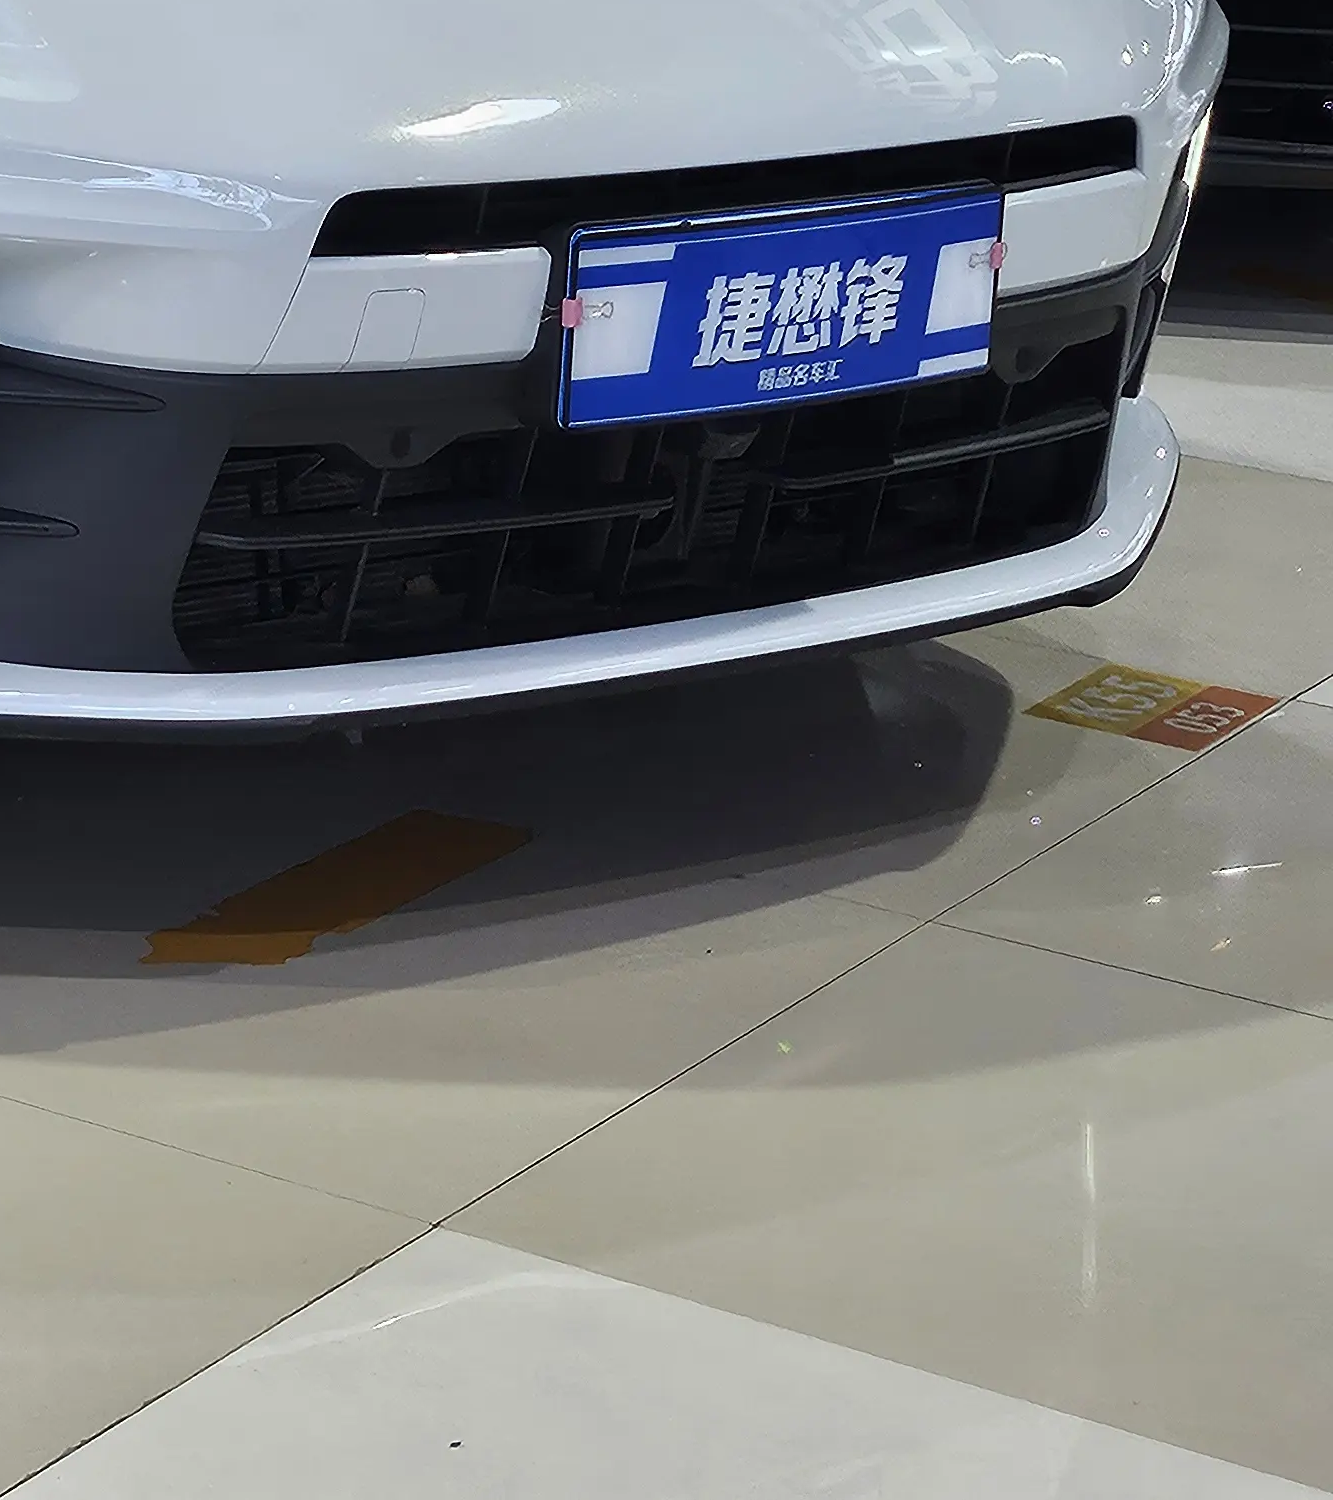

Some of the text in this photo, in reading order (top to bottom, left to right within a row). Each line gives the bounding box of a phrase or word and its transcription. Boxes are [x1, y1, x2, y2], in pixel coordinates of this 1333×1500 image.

[691, 255, 909, 368] 捷懋锋
[758, 359, 844, 391] 精品名车汇
